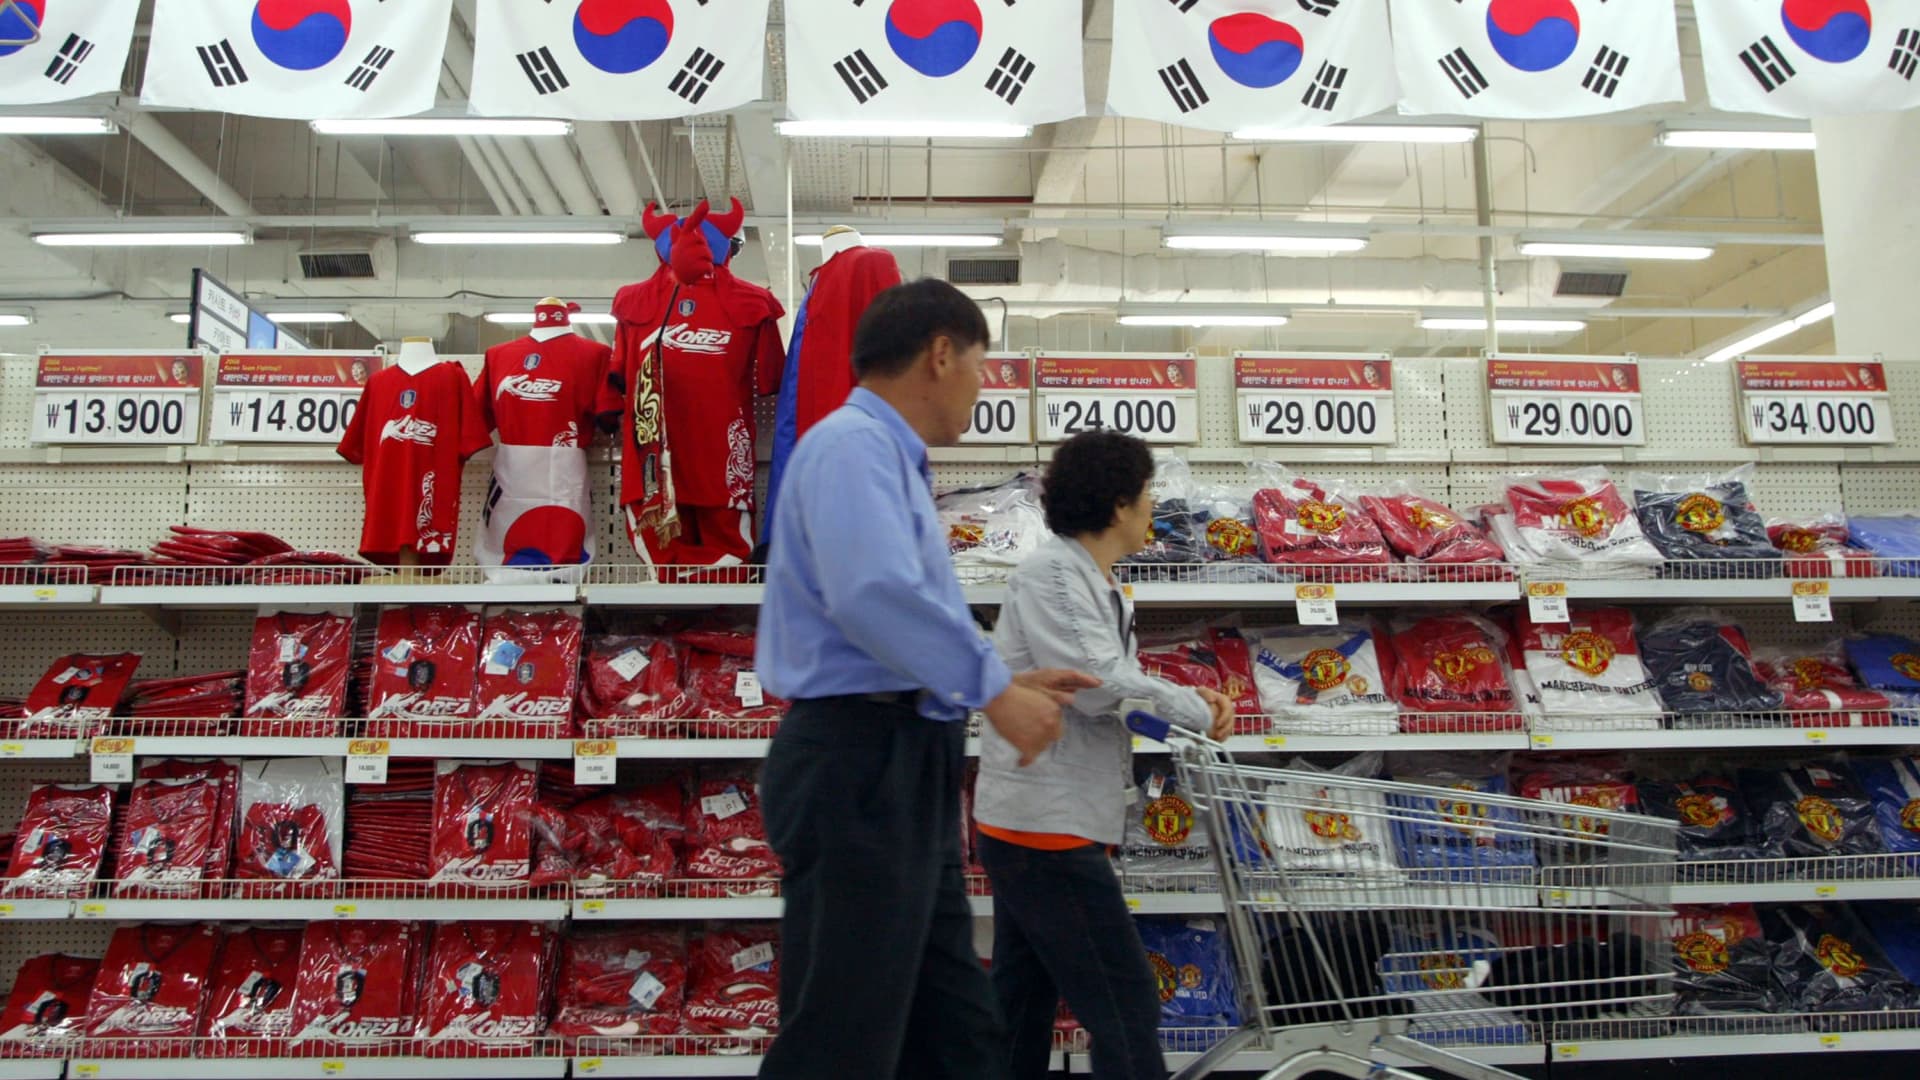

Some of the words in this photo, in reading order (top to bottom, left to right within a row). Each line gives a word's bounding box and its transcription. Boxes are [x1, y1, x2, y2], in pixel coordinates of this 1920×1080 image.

[640, 322, 732, 354] KOREA
[496, 374, 562, 401] KOREA
[46, 399, 183, 434] ₩13.900
[1248, 400, 1376, 435] ₩29.000
[1508, 402, 1633, 436] ₩29.000
[1752, 401, 1875, 435] ₩34.000
[368, 692, 472, 723] KOREA
[477, 692, 572, 723] KOREA
[428, 854, 530, 889] KOREA
[290, 1011, 398, 1046] KOREA
[430, 1010, 535, 1046] KOREA
